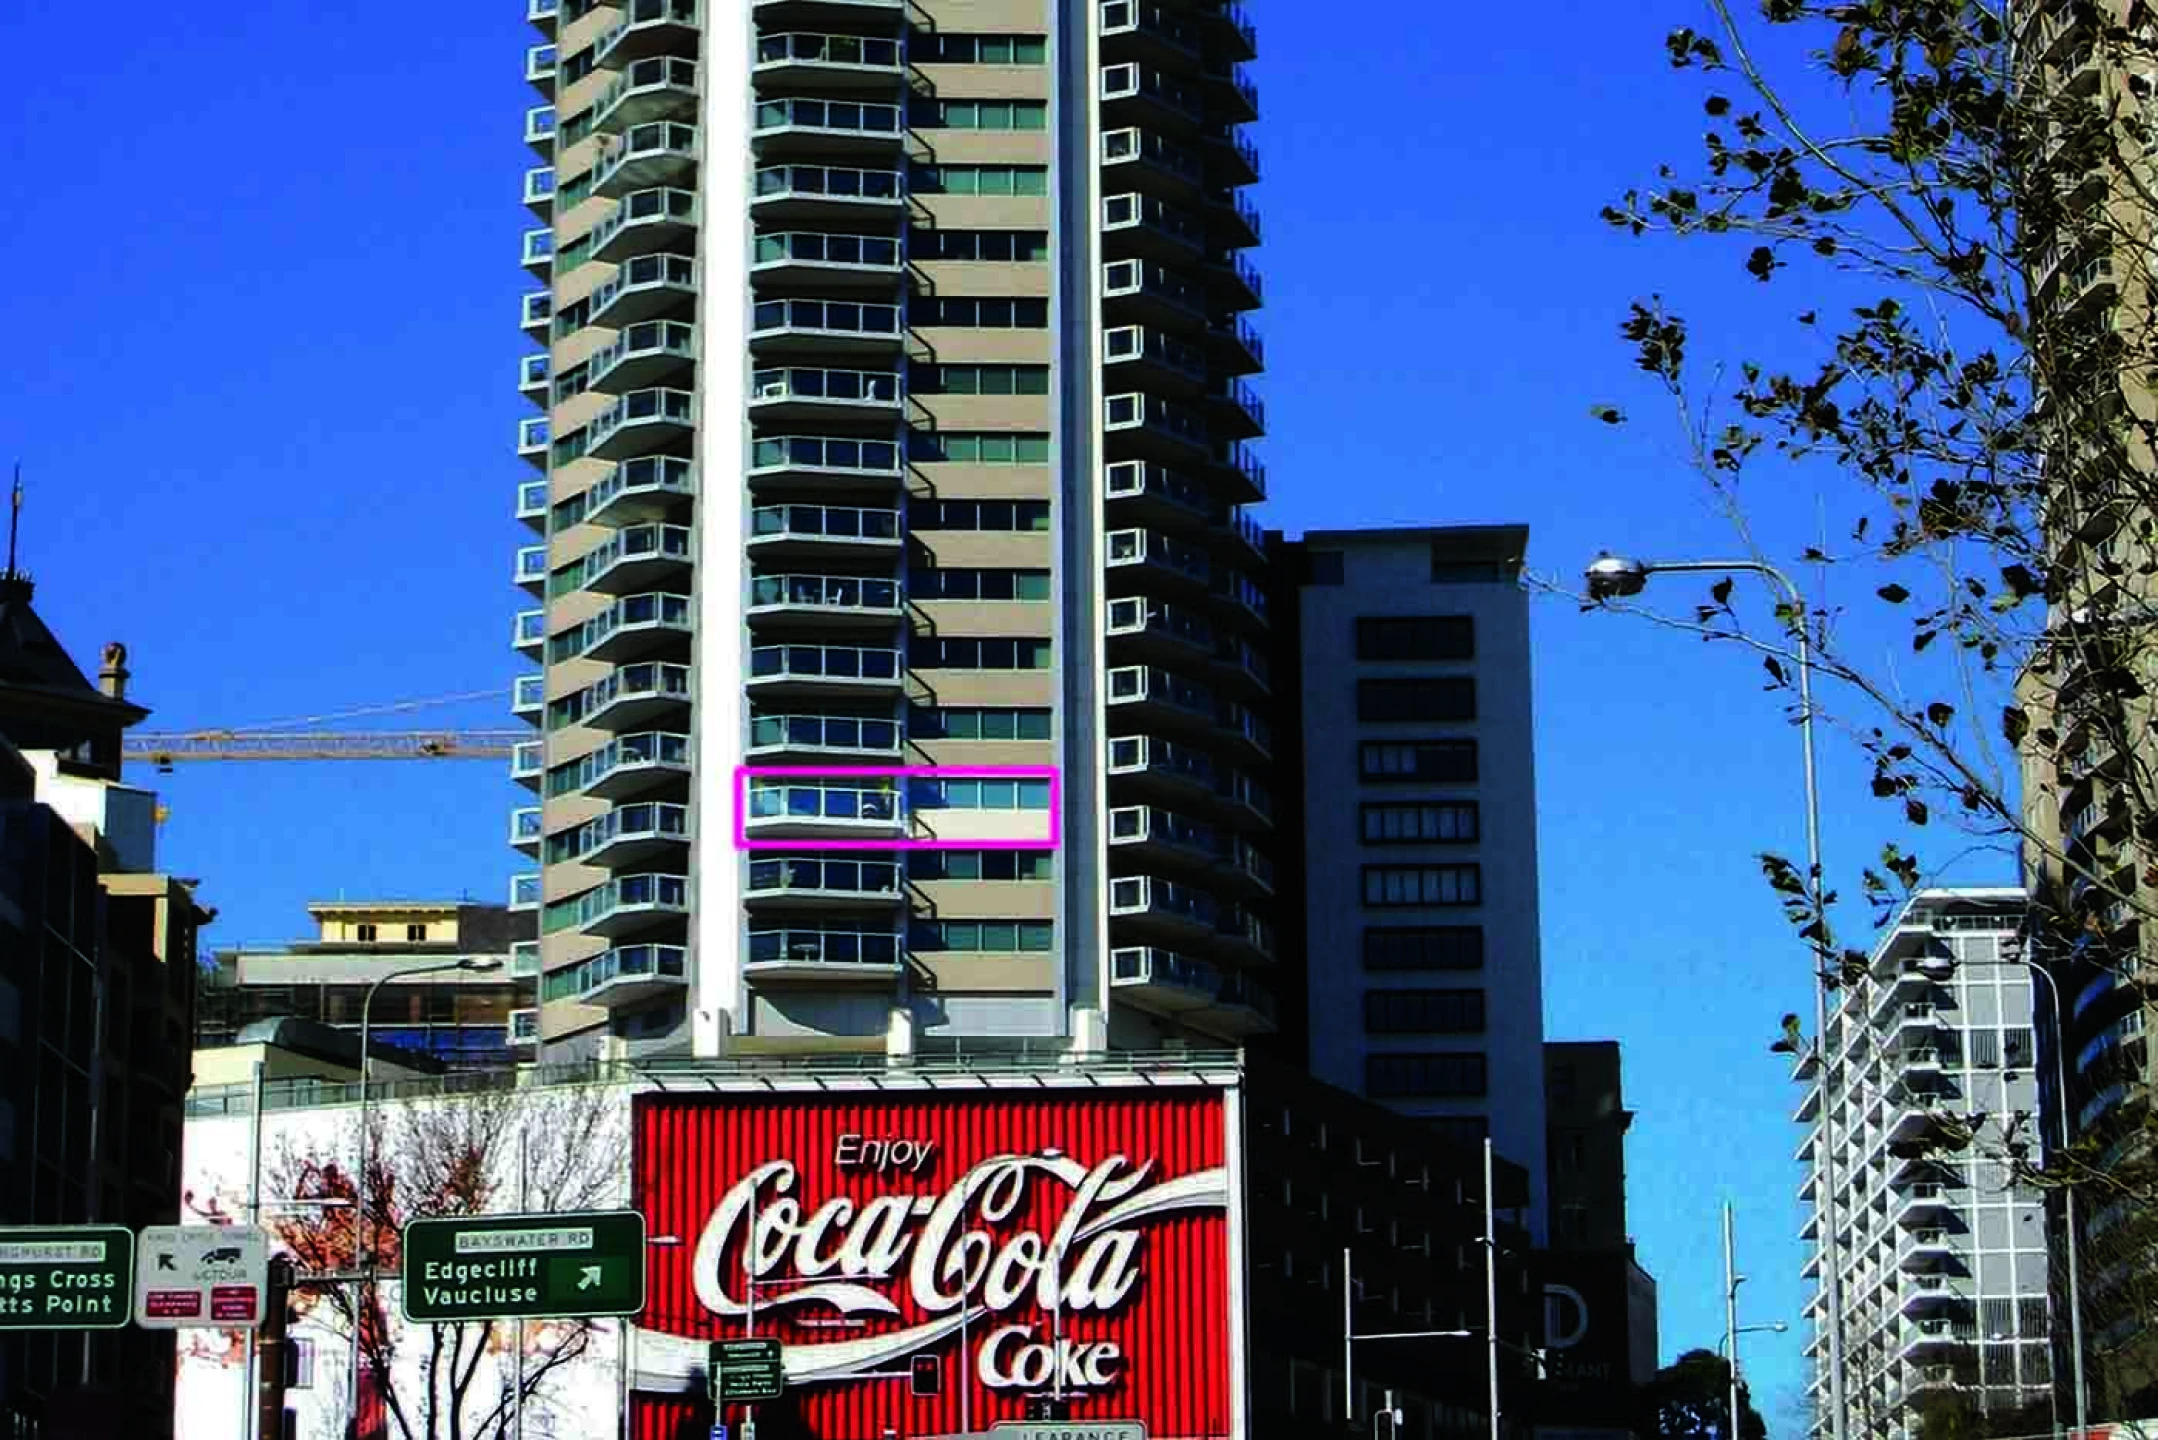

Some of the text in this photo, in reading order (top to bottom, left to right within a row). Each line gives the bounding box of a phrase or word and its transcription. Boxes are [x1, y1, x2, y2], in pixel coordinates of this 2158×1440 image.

[834, 1134, 933, 1171] Enjoy
[459, 1231, 590, 1248] BAYSWATER RD
[693, 1148, 1155, 1318] Coca-Cola
[50, 1270, 116, 1288] Cross
[424, 1258, 537, 1285] Edgecliff
[47, 1295, 112, 1313] Point
[423, 1284, 538, 1306] Vaucluse
[978, 1325, 1120, 1387] Coke
